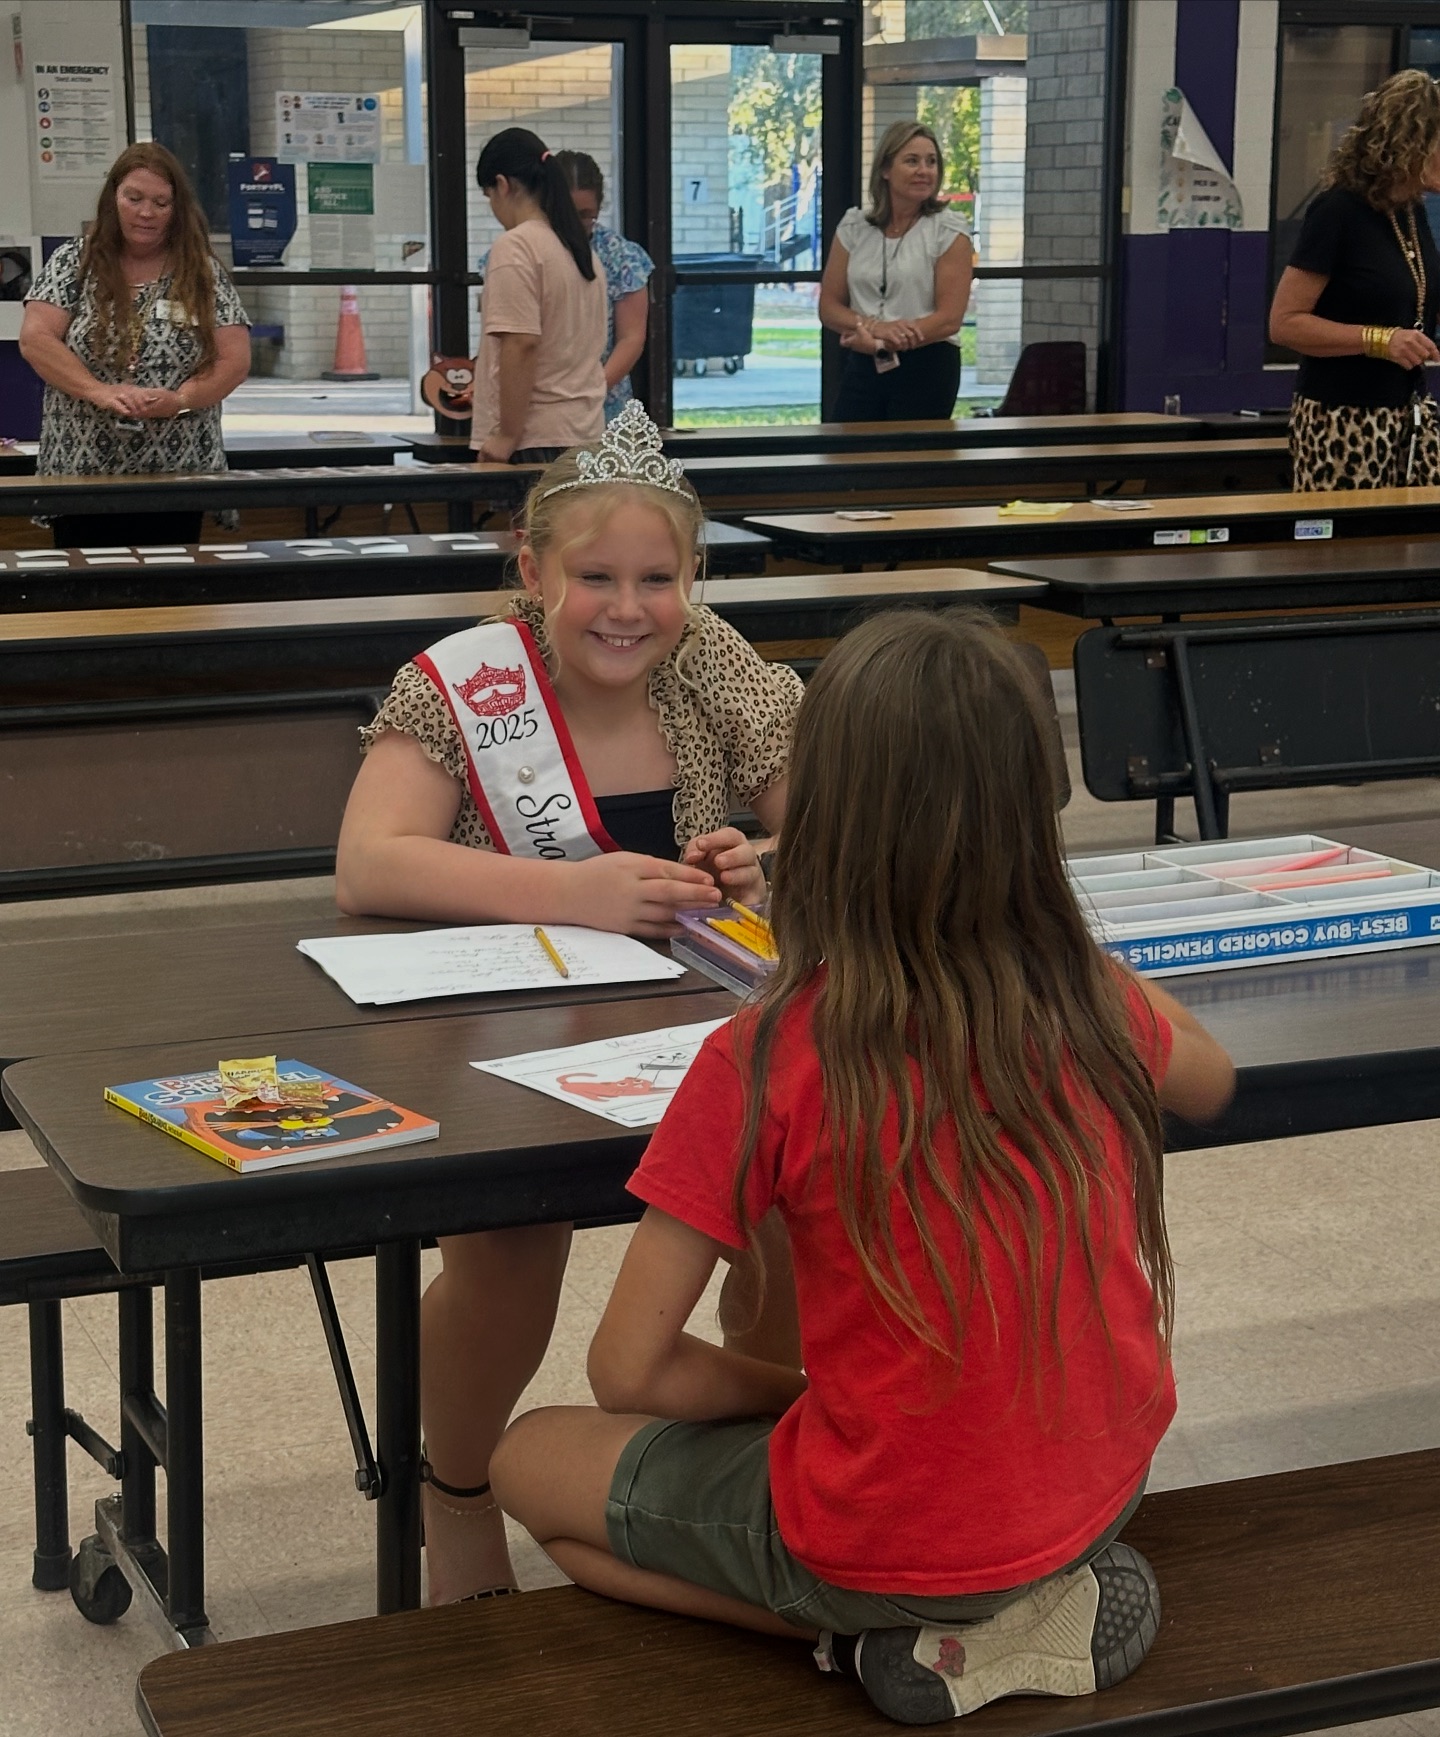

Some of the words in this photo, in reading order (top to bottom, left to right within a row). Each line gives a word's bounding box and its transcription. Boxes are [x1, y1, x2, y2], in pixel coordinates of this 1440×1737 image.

[690, 181, 701, 201] 7
[475, 708, 539, 752] 2025
[1218, 930, 1308, 951] COLORED
[1313, 915, 1408, 942] BEST-BUY
[1129, 940, 1213, 964] PENCILS
